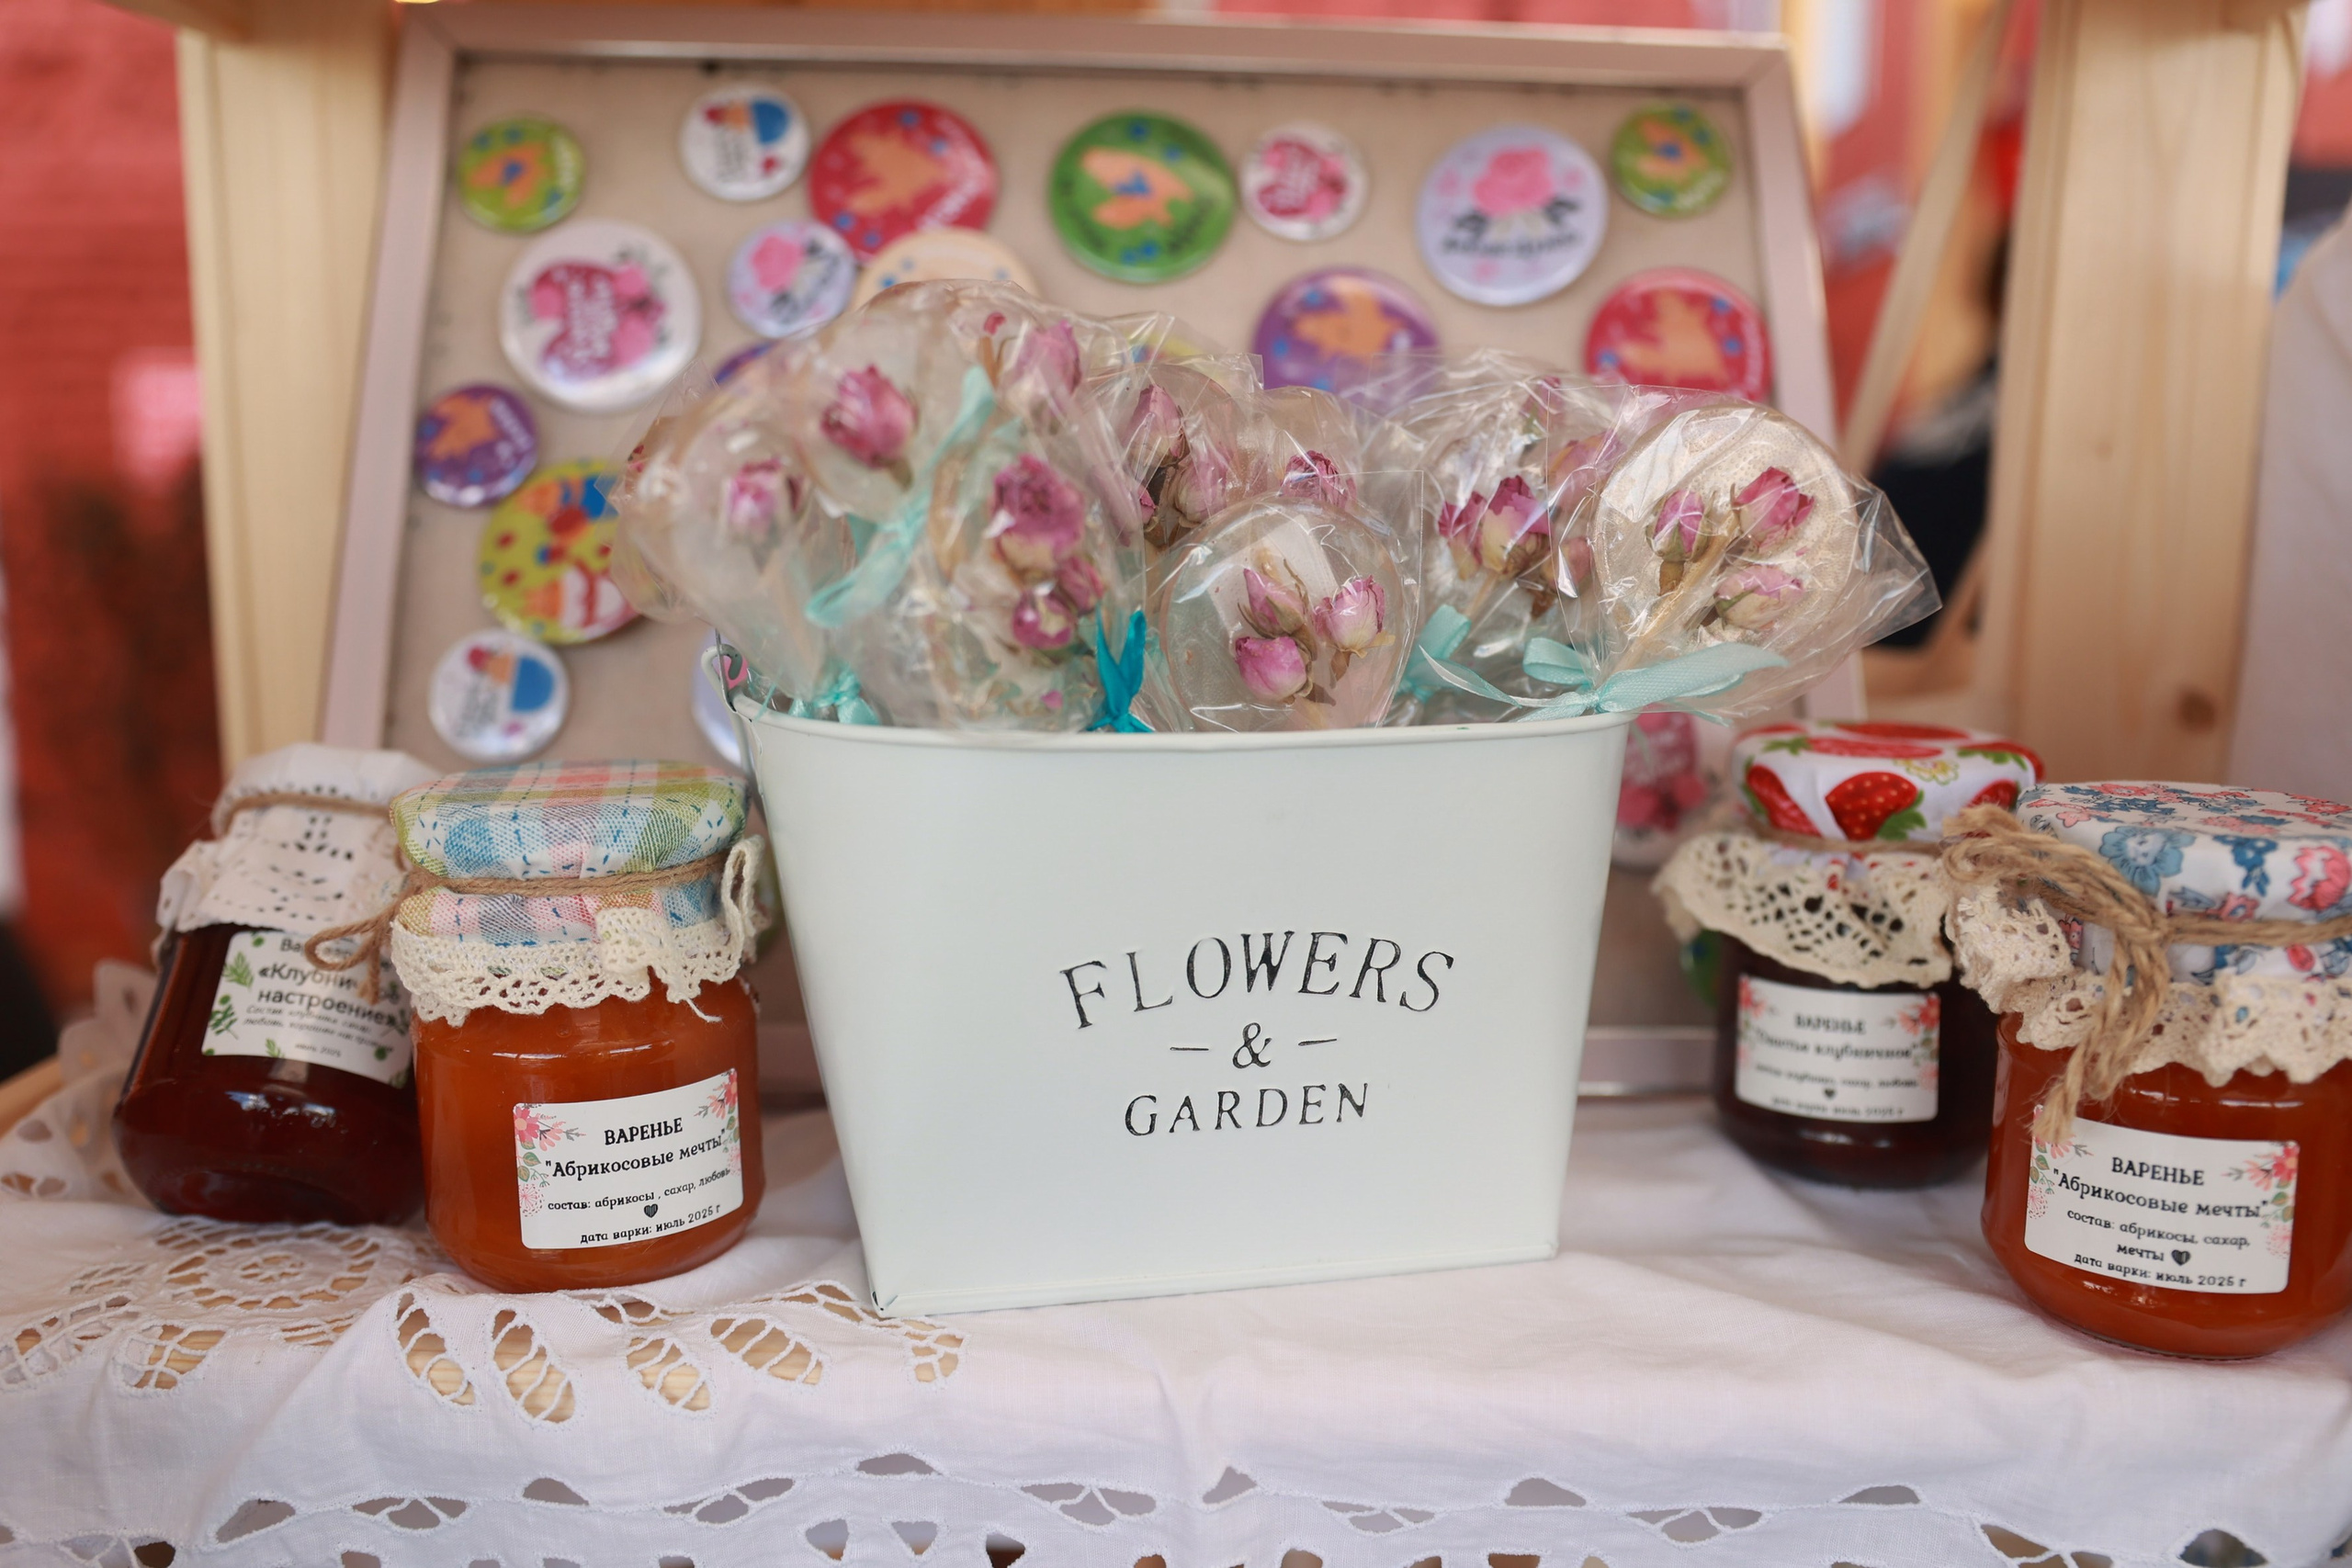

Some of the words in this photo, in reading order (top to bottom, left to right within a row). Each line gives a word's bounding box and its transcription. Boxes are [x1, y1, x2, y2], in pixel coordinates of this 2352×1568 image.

[1059, 931, 1455, 1030] FLOWERS
[1232, 1022, 1272, 1068] &
[1125, 1083, 1368, 1136] GARDEN
[604, 1117, 684, 1145] ВАРЕНЬЕ
[545, 1152, 674, 1181] "Абрикосовые
[678, 1128, 727, 1161] мечты"
[2111, 1156, 2205, 1187] ВАРЕНЬЕ
[548, 1198, 592, 1211] состав:
[594, 1191, 655, 1209] абрикосы
[663, 1181, 696, 1198] сахар,
[698, 1168, 731, 1187] любовь
[2052, 1168, 2188, 1214] "Абрикосовые
[2195, 1200, 2268, 1219] мечты"
[580, 1233, 609, 1245] дата
[612, 1224, 652, 1240] варки:
[655, 1217, 685, 1233] июль
[687, 1208, 715, 1224] 2025
[2067, 1208, 2115, 1230] состав:
[2202, 1235, 2251, 1250] сахар,
[2074, 1253, 2103, 1269] дата
[2107, 1260, 2153, 1279] варки:
[2155, 1270, 2193, 1286] июль
[2198, 1274, 2235, 1288] 2025
[2116, 1243, 2165, 1262] мечты
